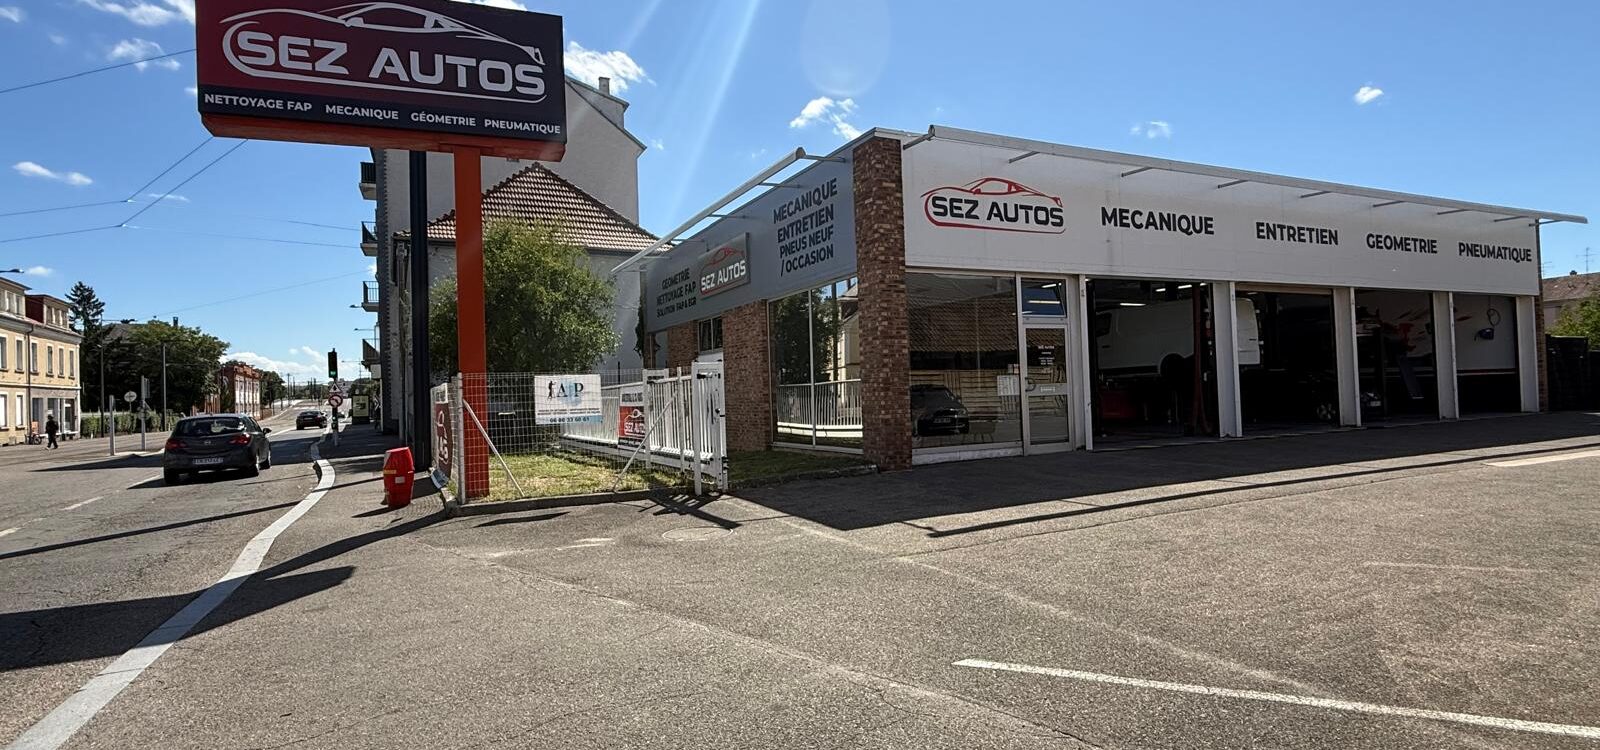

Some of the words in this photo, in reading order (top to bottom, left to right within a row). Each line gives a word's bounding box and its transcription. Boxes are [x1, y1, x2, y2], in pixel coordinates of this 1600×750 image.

[237, 30, 350, 75] SEZ
[368, 47, 546, 96] AUTOS
[204, 93, 284, 110] NETTOYAGE
[287, 100, 312, 112] FAP
[325, 104, 399, 120] MECANIQUE
[411, 110, 476, 127] GÉOMETRIE
[484, 119, 561, 135] PNEUMATIQUE
[773, 178, 838, 224] MECANIQUE
[931, 195, 980, 220] SEZ
[987, 201, 1064, 227] AUTOS
[777, 203, 834, 243] ENTRETIEN
[1100, 206, 1215, 236] MECANIQUE
[1255, 221, 1339, 246] ENTRETIEN
[780, 236, 807, 259] PNEUS
[808, 224, 834, 248] NEUF
[1366, 232, 1438, 254] GEOMETRIE
[1458, 242, 1532, 262] PNEUMATIQUE
[701, 272, 715, 291] SEZ
[717, 260, 746, 285] AUTOS
[656, 286, 684, 306] NETTOYAGE
[684, 281, 697, 295] FAP
